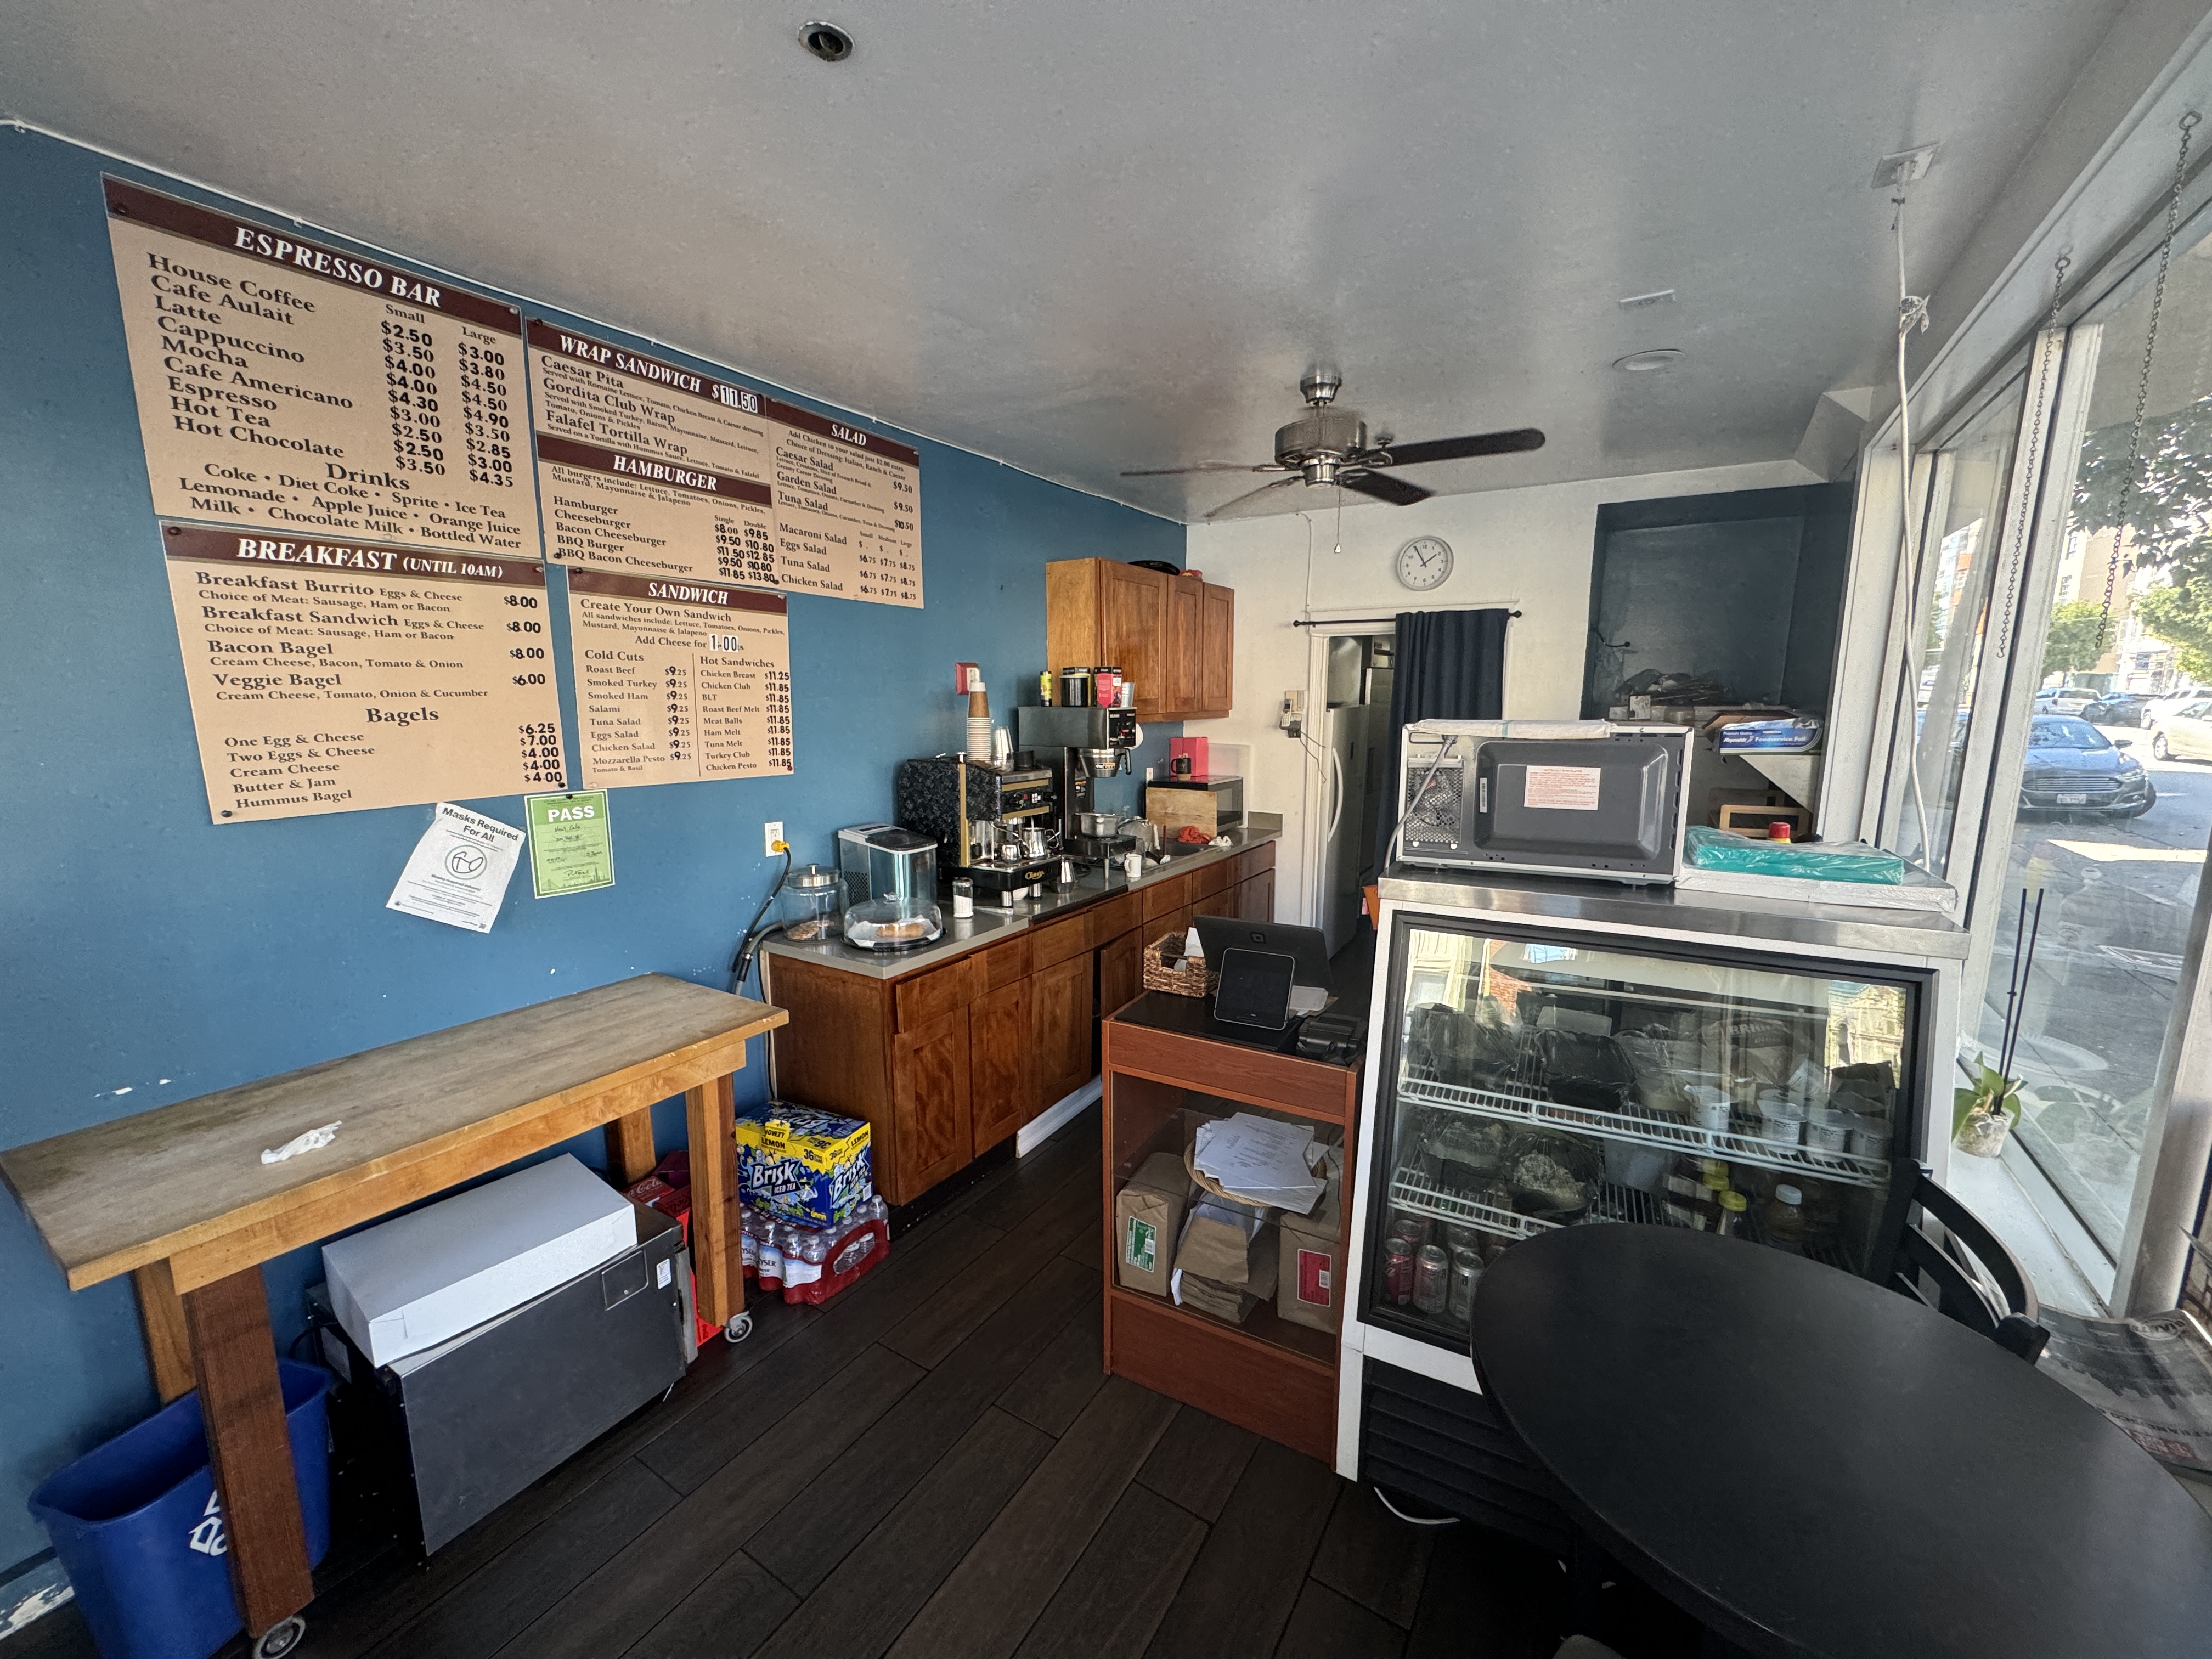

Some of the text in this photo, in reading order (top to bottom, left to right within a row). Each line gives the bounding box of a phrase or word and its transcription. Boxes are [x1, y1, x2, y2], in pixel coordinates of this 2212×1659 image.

[235, 227, 439, 307] ESPRESSO BAR
[146, 252, 315, 312] House Coffee
[151, 275, 294, 325] Cafe Aulait
[154, 294, 222, 324] Latte
[386, 304, 425, 324] Small
[158, 316, 304, 363] Cappuccino
[381, 320, 432, 347] $2.50
[462, 326, 496, 345] Large
[161, 335, 249, 368] Mocha
[383, 337, 434, 362] $3.50
[385, 354, 436, 379] $4.00
[541, 356, 624, 388] Caesar Pita
[561, 335, 701, 392] WRAP SANDWICH
[164, 357, 353, 408] Cafe Americano
[166, 375, 277, 410] Espresso
[386, 371, 437, 395] $4.00
[388, 388, 438, 412] $4.30
[543, 377, 675, 427] Gordita Club Wrap
[712, 384, 758, 413] $11.50
[169, 395, 271, 427] Hot Tea
[172, 415, 344, 458] Hot Chocolate
[546, 409, 687, 456] Falafel Tortilla Wrap
[803, 436, 826, 447] Chicken
[832, 425, 866, 445] SALAD
[776, 447, 833, 471] Caesar Salad
[325, 462, 410, 490] Drinks
[614, 455, 716, 490] HAMBURGER
[777, 471, 837, 494] Garden Salad
[204, 464, 506, 518] Coke Diet Coke Sprite Ice Tea
[552, 467, 765, 514] All burgers include: Lettuce, Tomatoes, Onions, Pickles,
[893, 481, 912, 493] $9.50
[554, 496, 618, 516] Hamburger
[555, 509, 631, 530] Cheeseburger
[715, 515, 734, 524] Single
[715, 524, 738, 534] $8.00
[744, 521, 766, 529] Double
[556, 522, 666, 548] Bacon Cheeseburger
[557, 535, 624, 553] BBQ Burger
[716, 534, 741, 546] $9.50
[744, 528, 768, 540] $9.85
[237, 539, 397, 569] BREAKFAST
[780, 538, 827, 555] Eggs Salad
[404, 557, 502, 578] (UNTIL 10AM)
[195, 572, 374, 595] Breakfast Burrito
[781, 574, 843, 591] Chicken Salad
[380, 588, 406, 600] Eggs
[424, 591, 462, 601] Cheese
[504, 595, 537, 608] $8.00
[649, 583, 727, 604] SANDWICH
[581, 600, 731, 622] Create Your Own Sandwich
[635, 636, 707, 648] Add Cheese for
[585, 650, 644, 661] Cold Cuts
[700, 656, 774, 668] Hot Sandwiches
[512, 674, 545, 686] $6.00
[665, 666, 686, 676] $9.25
[765, 672, 789, 680] $11.25
[212, 674, 342, 690] Veggie Bagel
[365, 707, 439, 727] Bagels
[225, 733, 364, 748] One Egg & Cheese
[235, 789, 352, 808] Hummus Bagel
[548, 805, 595, 822] PASS
[443, 808, 518, 842] Masks Required
[463, 825, 495, 842] For All
[761, 1137, 785, 1149] LEMON
[815, 1141, 831, 1149] 36
[851, 1130, 868, 1147] LEMON
[803, 1149, 814, 1160] 36
[830, 1150, 837, 1160] 36
[774, 1183, 796, 1194] ICED TEA
